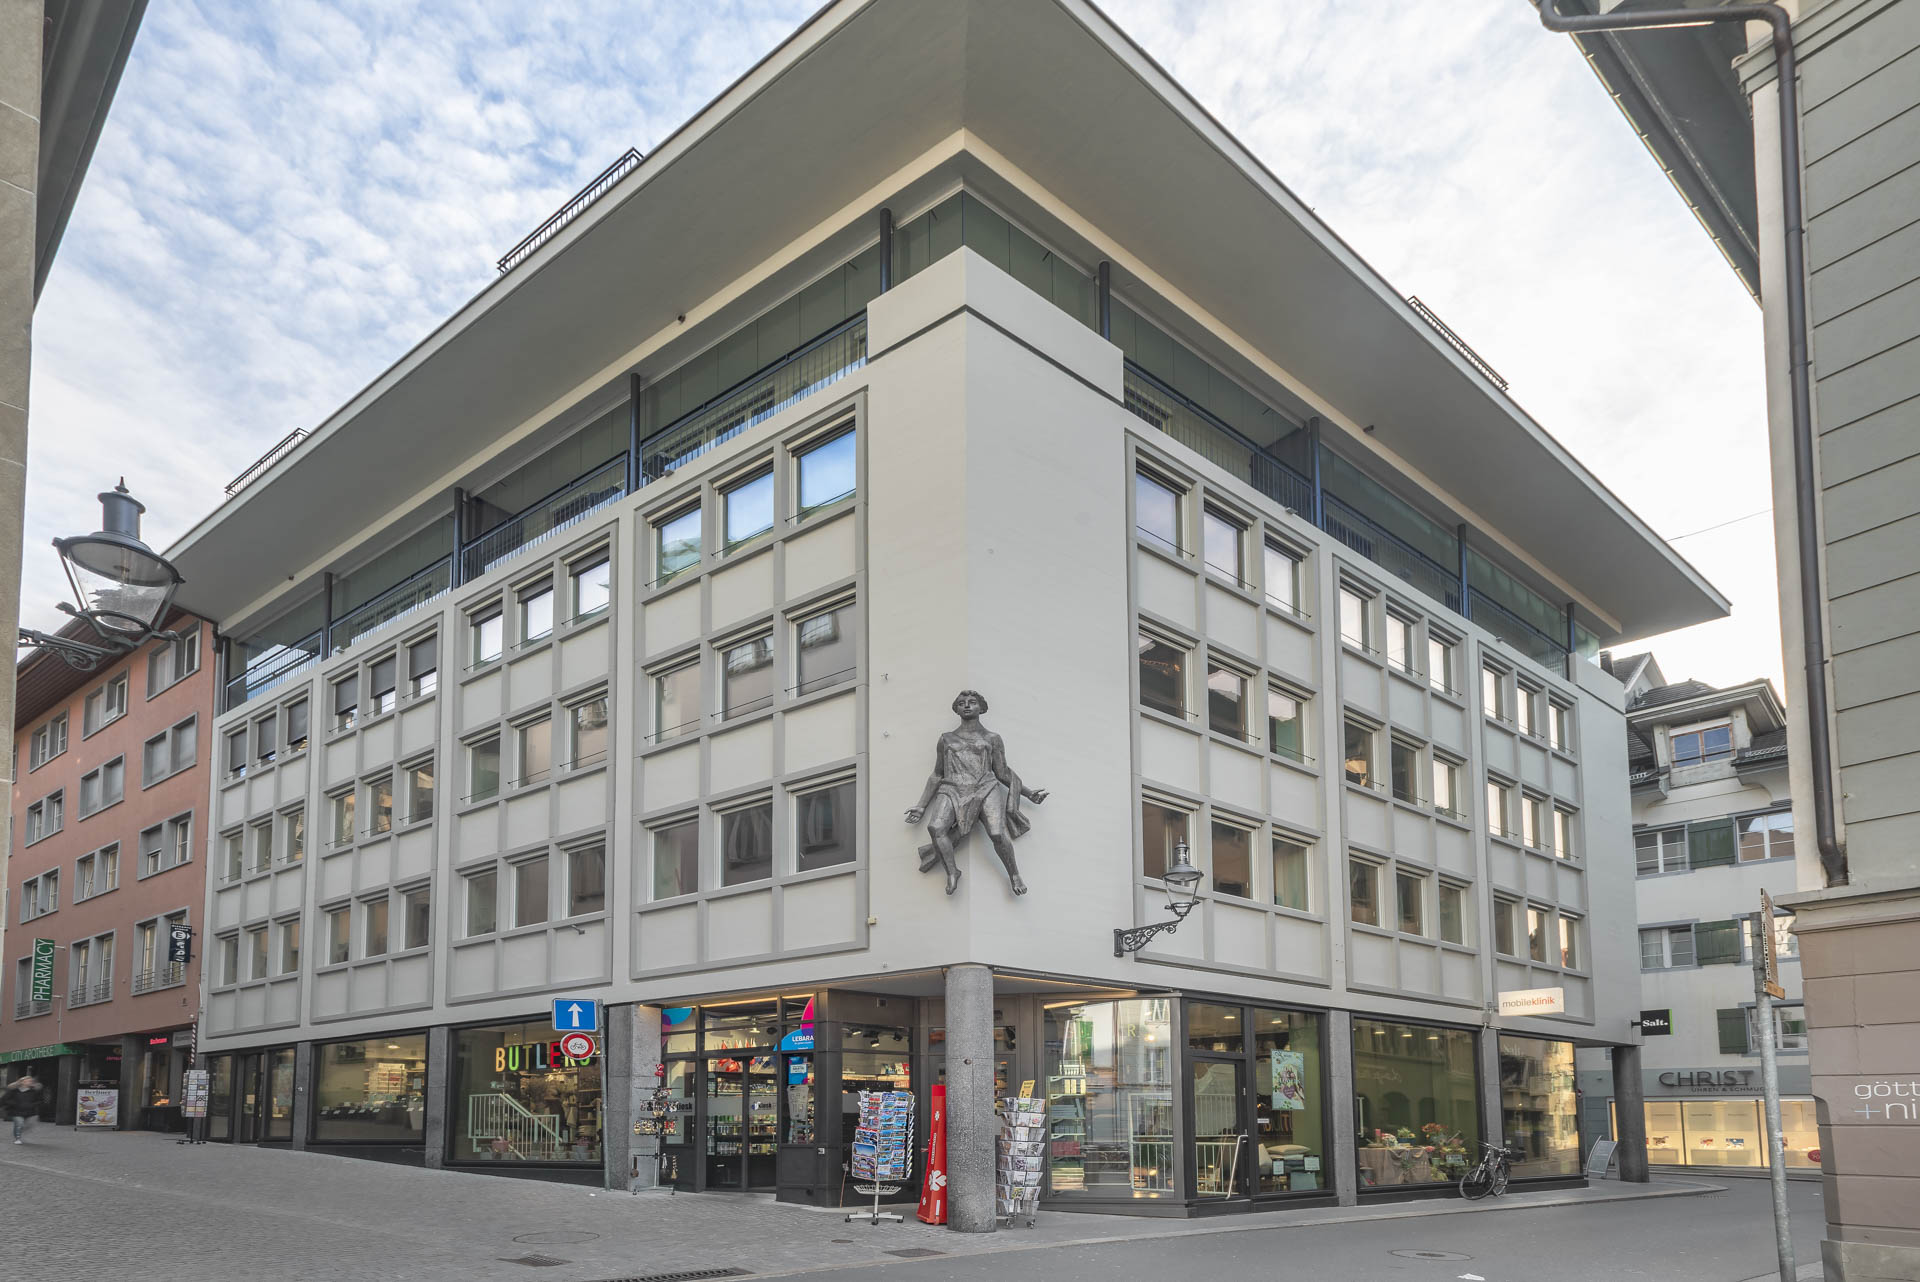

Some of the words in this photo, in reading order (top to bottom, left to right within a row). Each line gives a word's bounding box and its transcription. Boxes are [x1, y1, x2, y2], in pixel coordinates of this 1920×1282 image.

[33, 939, 54, 1001] PHARMACY
[1502, 996, 1555, 1008] mobileklinik
[1642, 1019, 1668, 1027] Salt.
[11, 1050, 23, 1062] CITY
[24, 1046, 54, 1060] APOTHEKE
[495, 1041, 591, 1072] BUTLE
[1659, 1070, 1754, 1087] CHRIST
